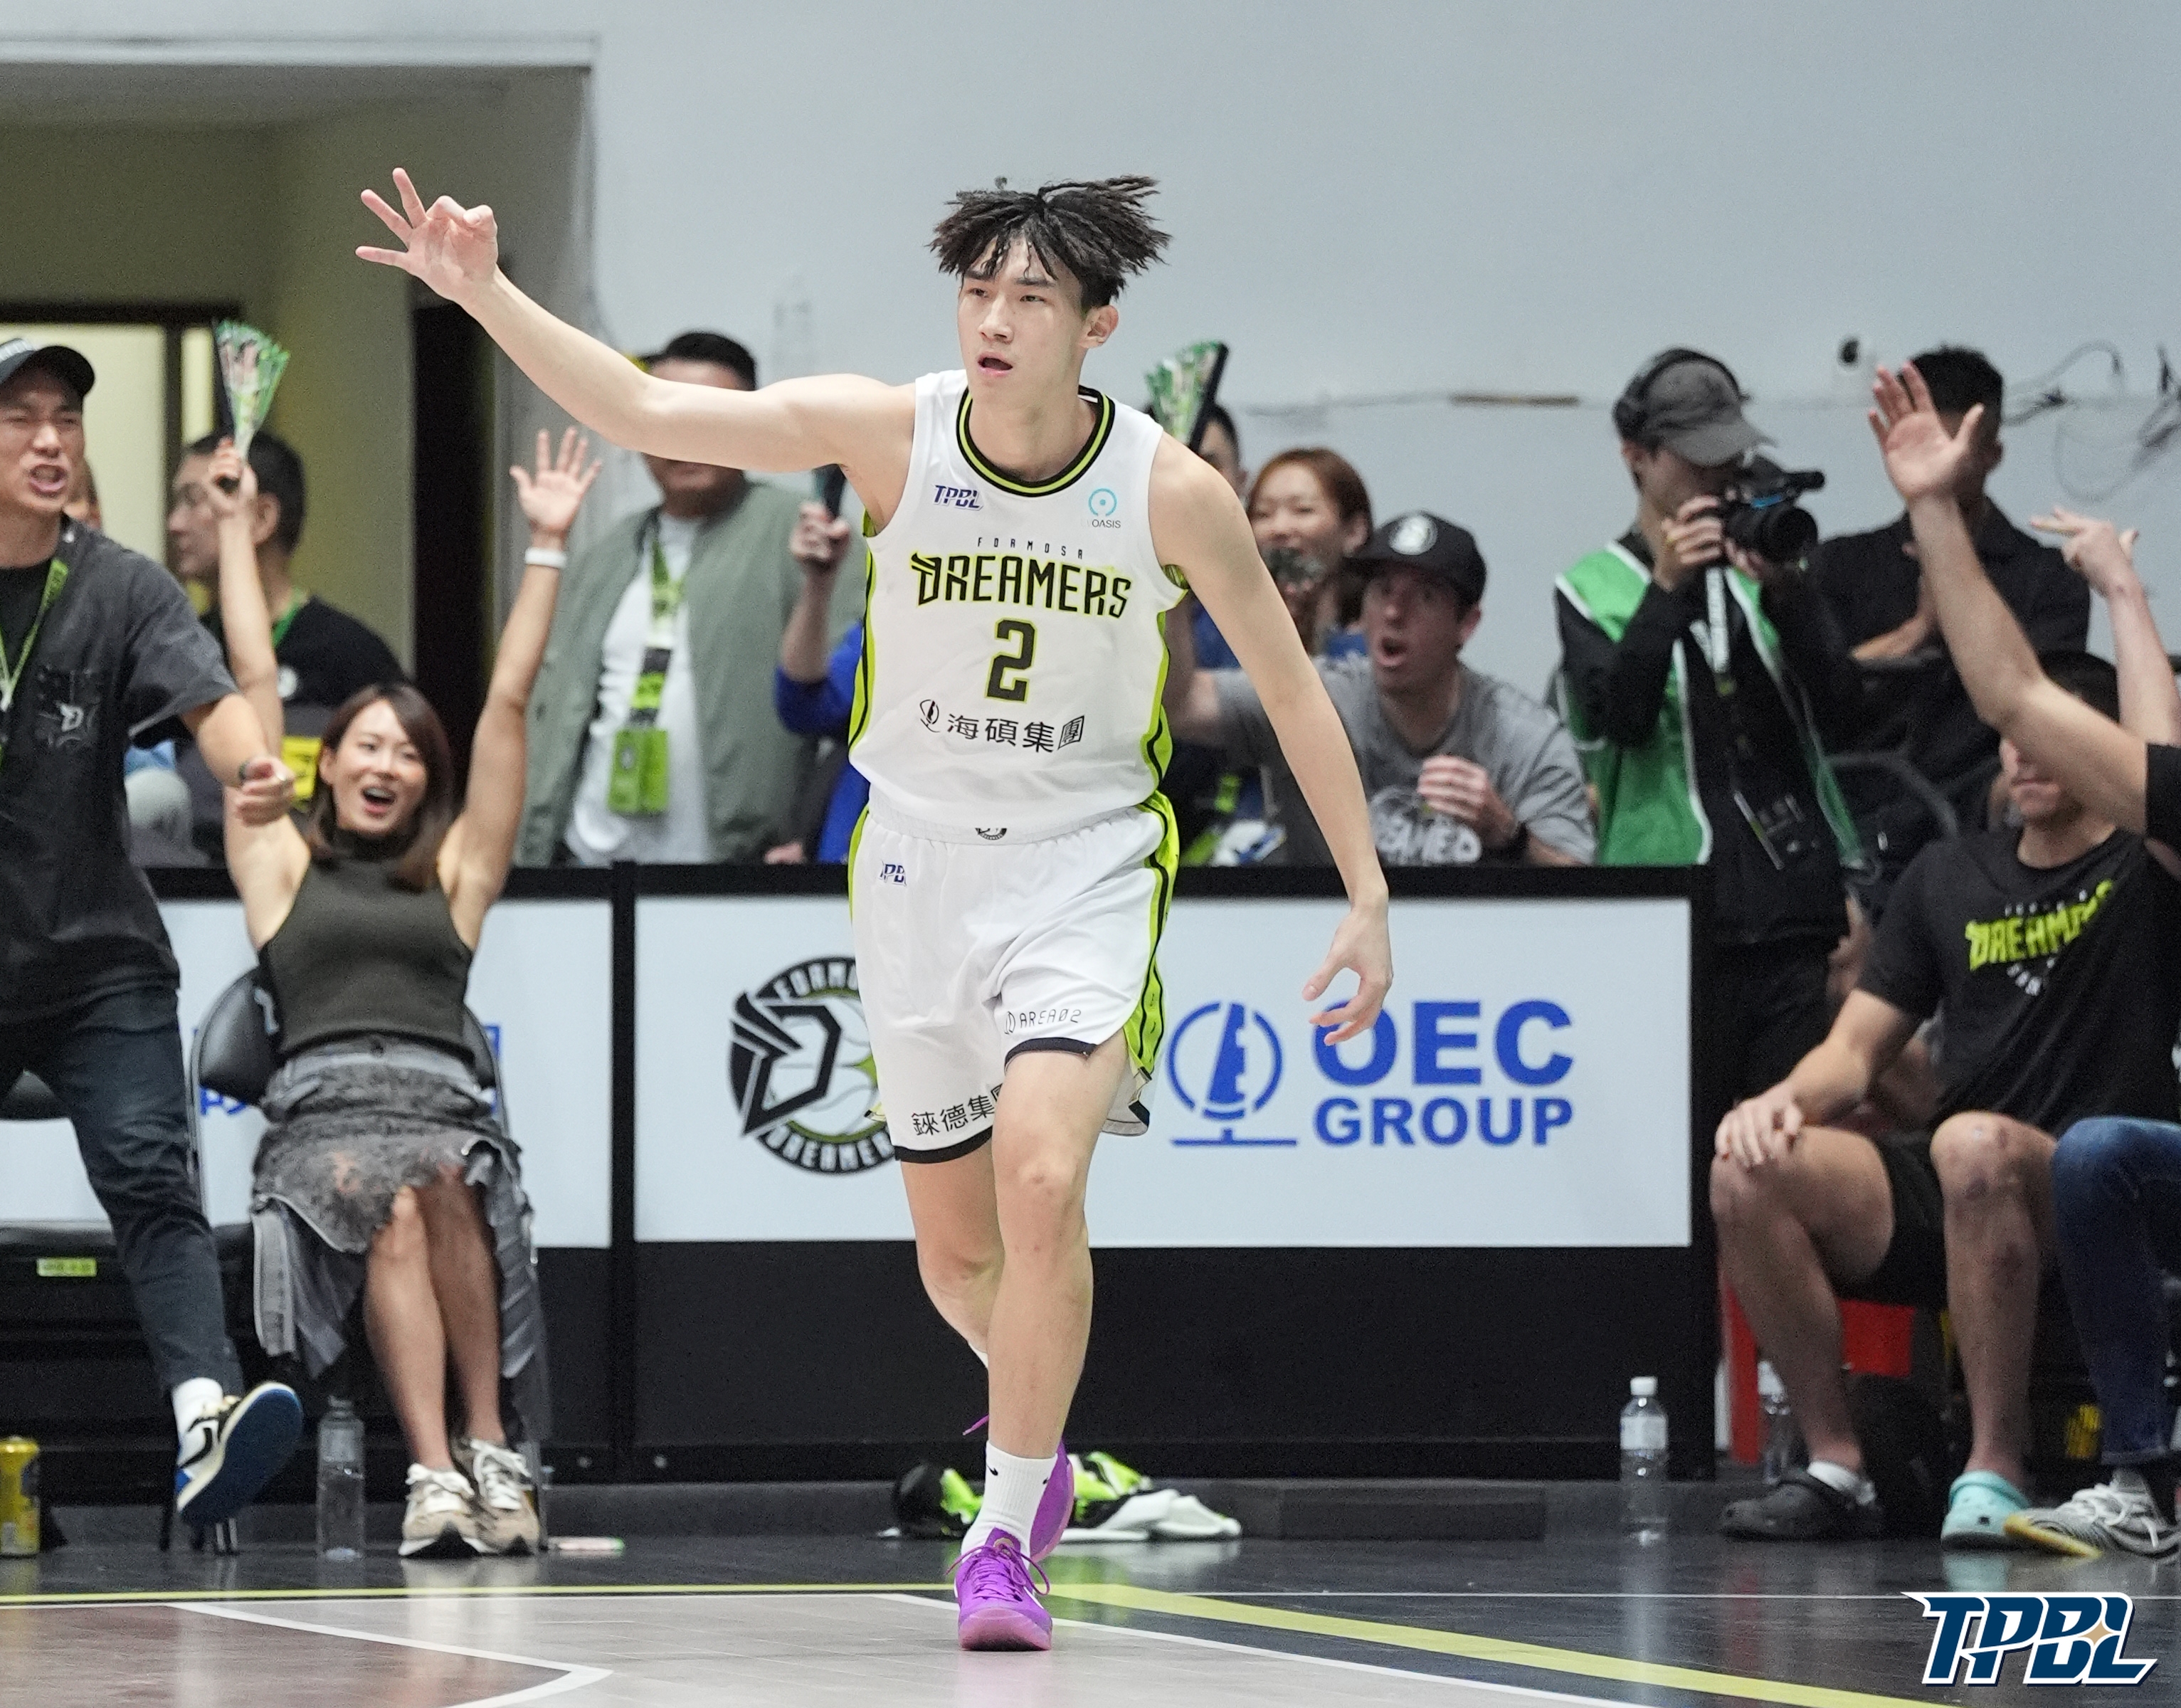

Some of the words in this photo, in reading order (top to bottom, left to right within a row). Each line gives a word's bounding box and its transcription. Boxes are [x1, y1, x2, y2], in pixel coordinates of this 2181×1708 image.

[933, 484, 983, 510] TPBL
[977, 537, 1083, 559] FORMOSA
[910, 552, 1133, 619] DREAMERS
[985, 618, 1037, 702] 2
[946, 713, 1084, 754] 海碩集團
[1311, 998, 1574, 1087] OEC
[910, 1082, 1003, 1136] 錸德集
[1313, 1096, 1573, 1147] GROUP
